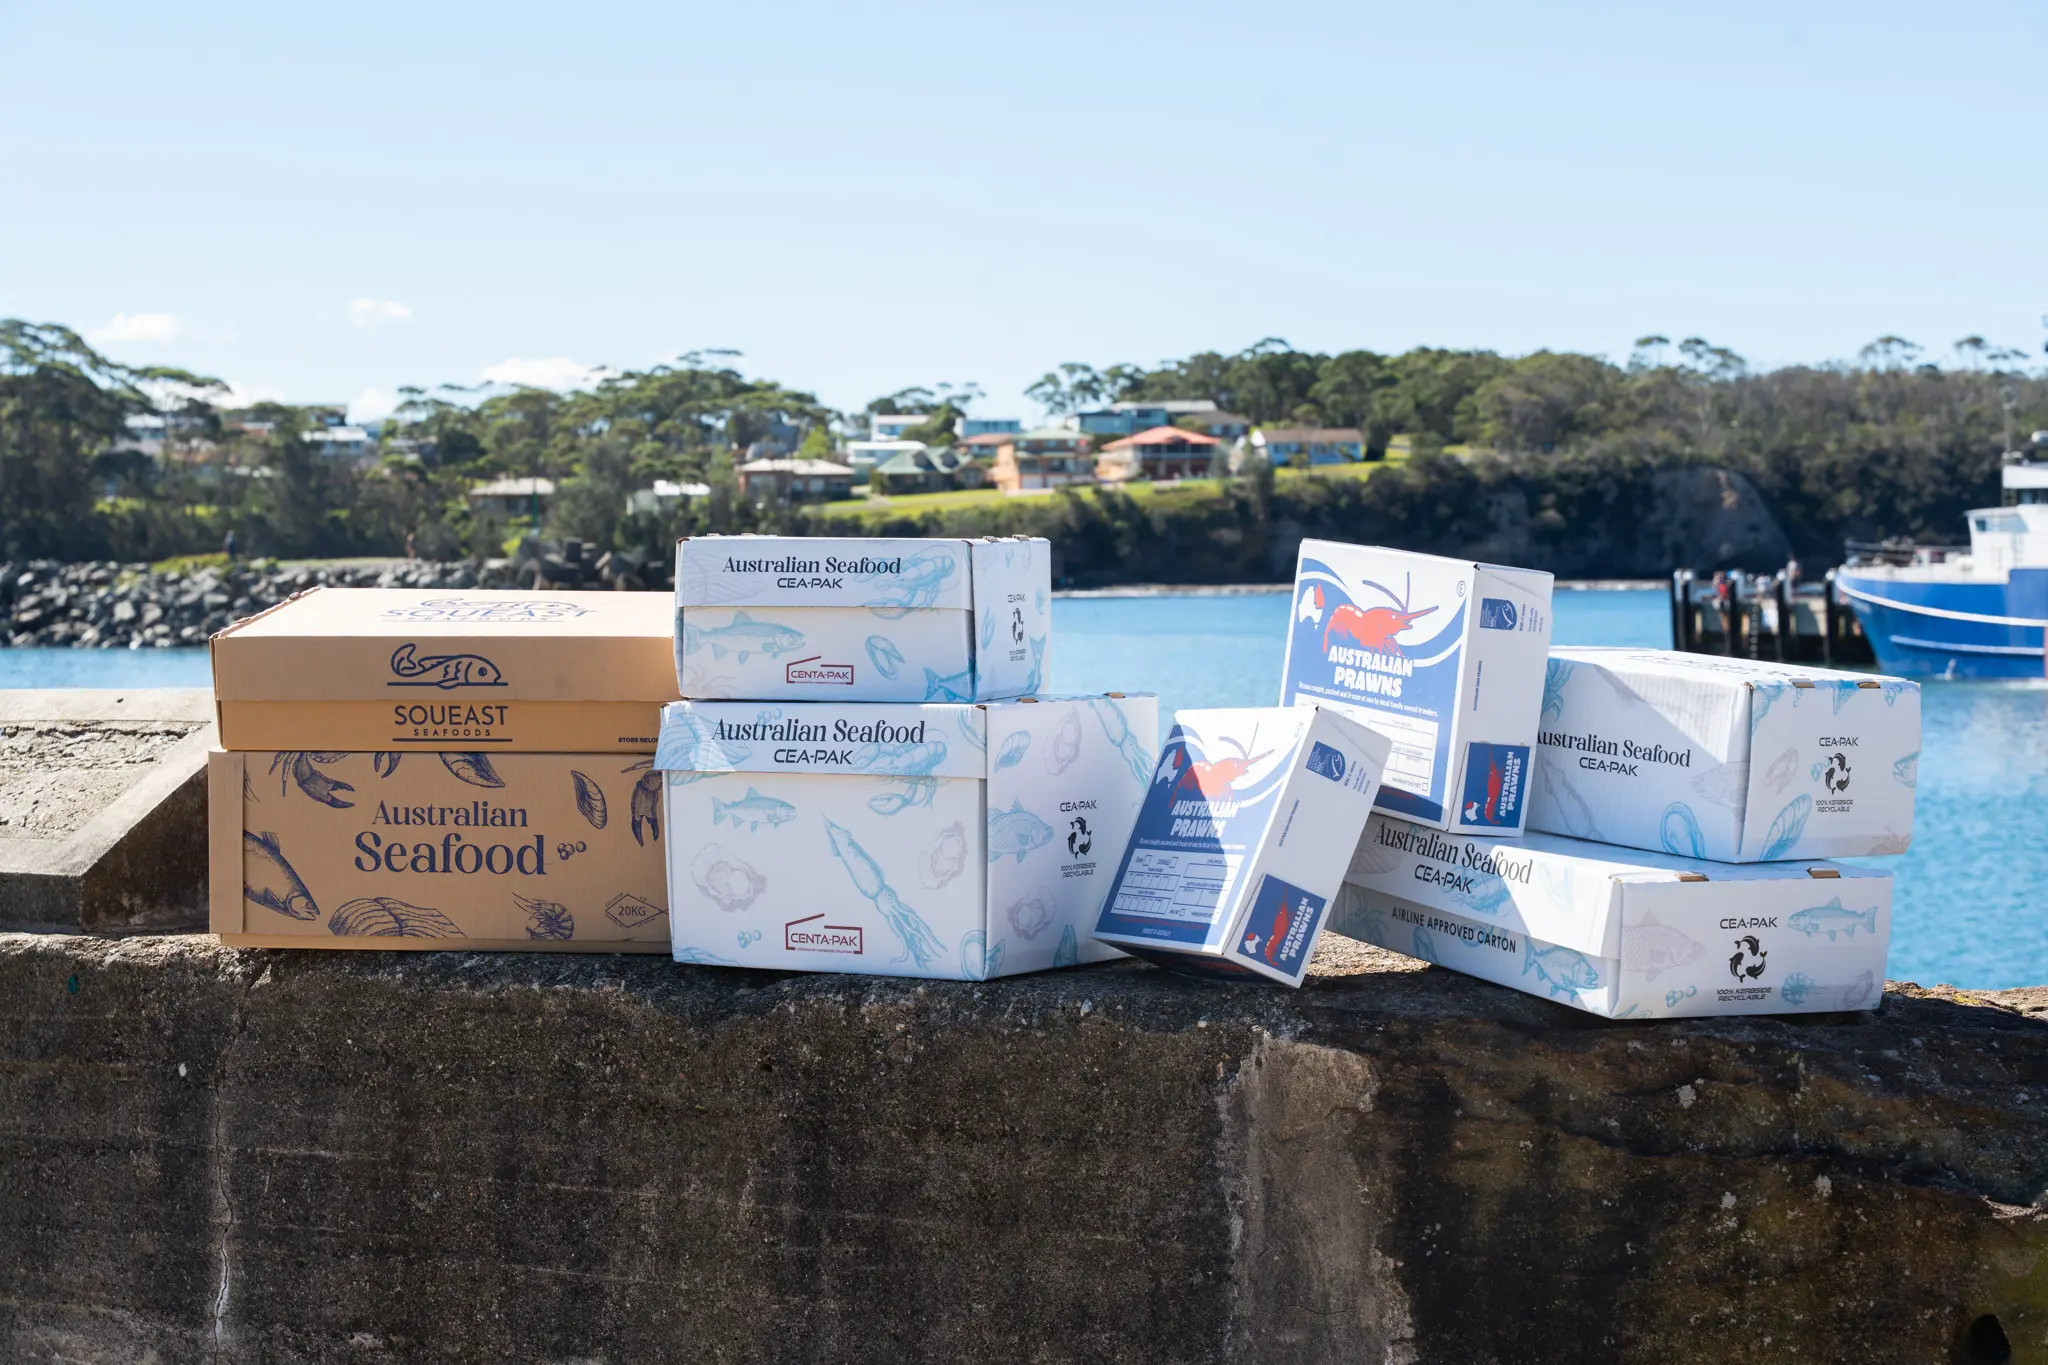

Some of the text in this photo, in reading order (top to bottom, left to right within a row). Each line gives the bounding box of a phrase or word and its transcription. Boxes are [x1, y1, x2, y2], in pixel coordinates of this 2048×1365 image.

[722, 556, 902, 574] Australian Seafood
[777, 578, 843, 588] CEA-PAK
[380, 609, 597, 618] SOUEAST
[1328, 645, 1413, 678] AUSTRALIAN
[791, 670, 850, 680] CENTA-PAK
[1334, 666, 1402, 698] PRAWNS
[394, 705, 508, 726] SOUEAST
[414, 728, 491, 736] SEAFOODS
[712, 718, 926, 744] Australian Seafood
[1818, 737, 1858, 746] CEA-PAK
[774, 748, 854, 764] CEA-PAK
[1622, 740, 1691, 768] Seafood
[1579, 757, 1638, 776] CEA-PAK
[1499, 752, 1514, 817] AUSTRALIAN
[1507, 758, 1521, 810] PRAWNS
[371, 800, 528, 827] Australian
[1060, 800, 1097, 812] CEA-PAK
[1171, 800, 1240, 818] AUSTRALIAN
[1170, 818, 1227, 838] PRAWNS
[354, 832, 547, 875] Seafood
[1373, 820, 1533, 884] Australian Seafood
[1415, 864, 1474, 894] CEA-PAK
[618, 906, 646, 916] 20KG
[1280, 897, 1308, 961] AUSTRALIAN
[1289, 906, 1314, 958] PRAWNS
[1392, 906, 1516, 953] AIRLINE APPROVED CARTON
[1720, 917, 1778, 929] CEA-PAK
[790, 932, 858, 946] CENTA-PAK
